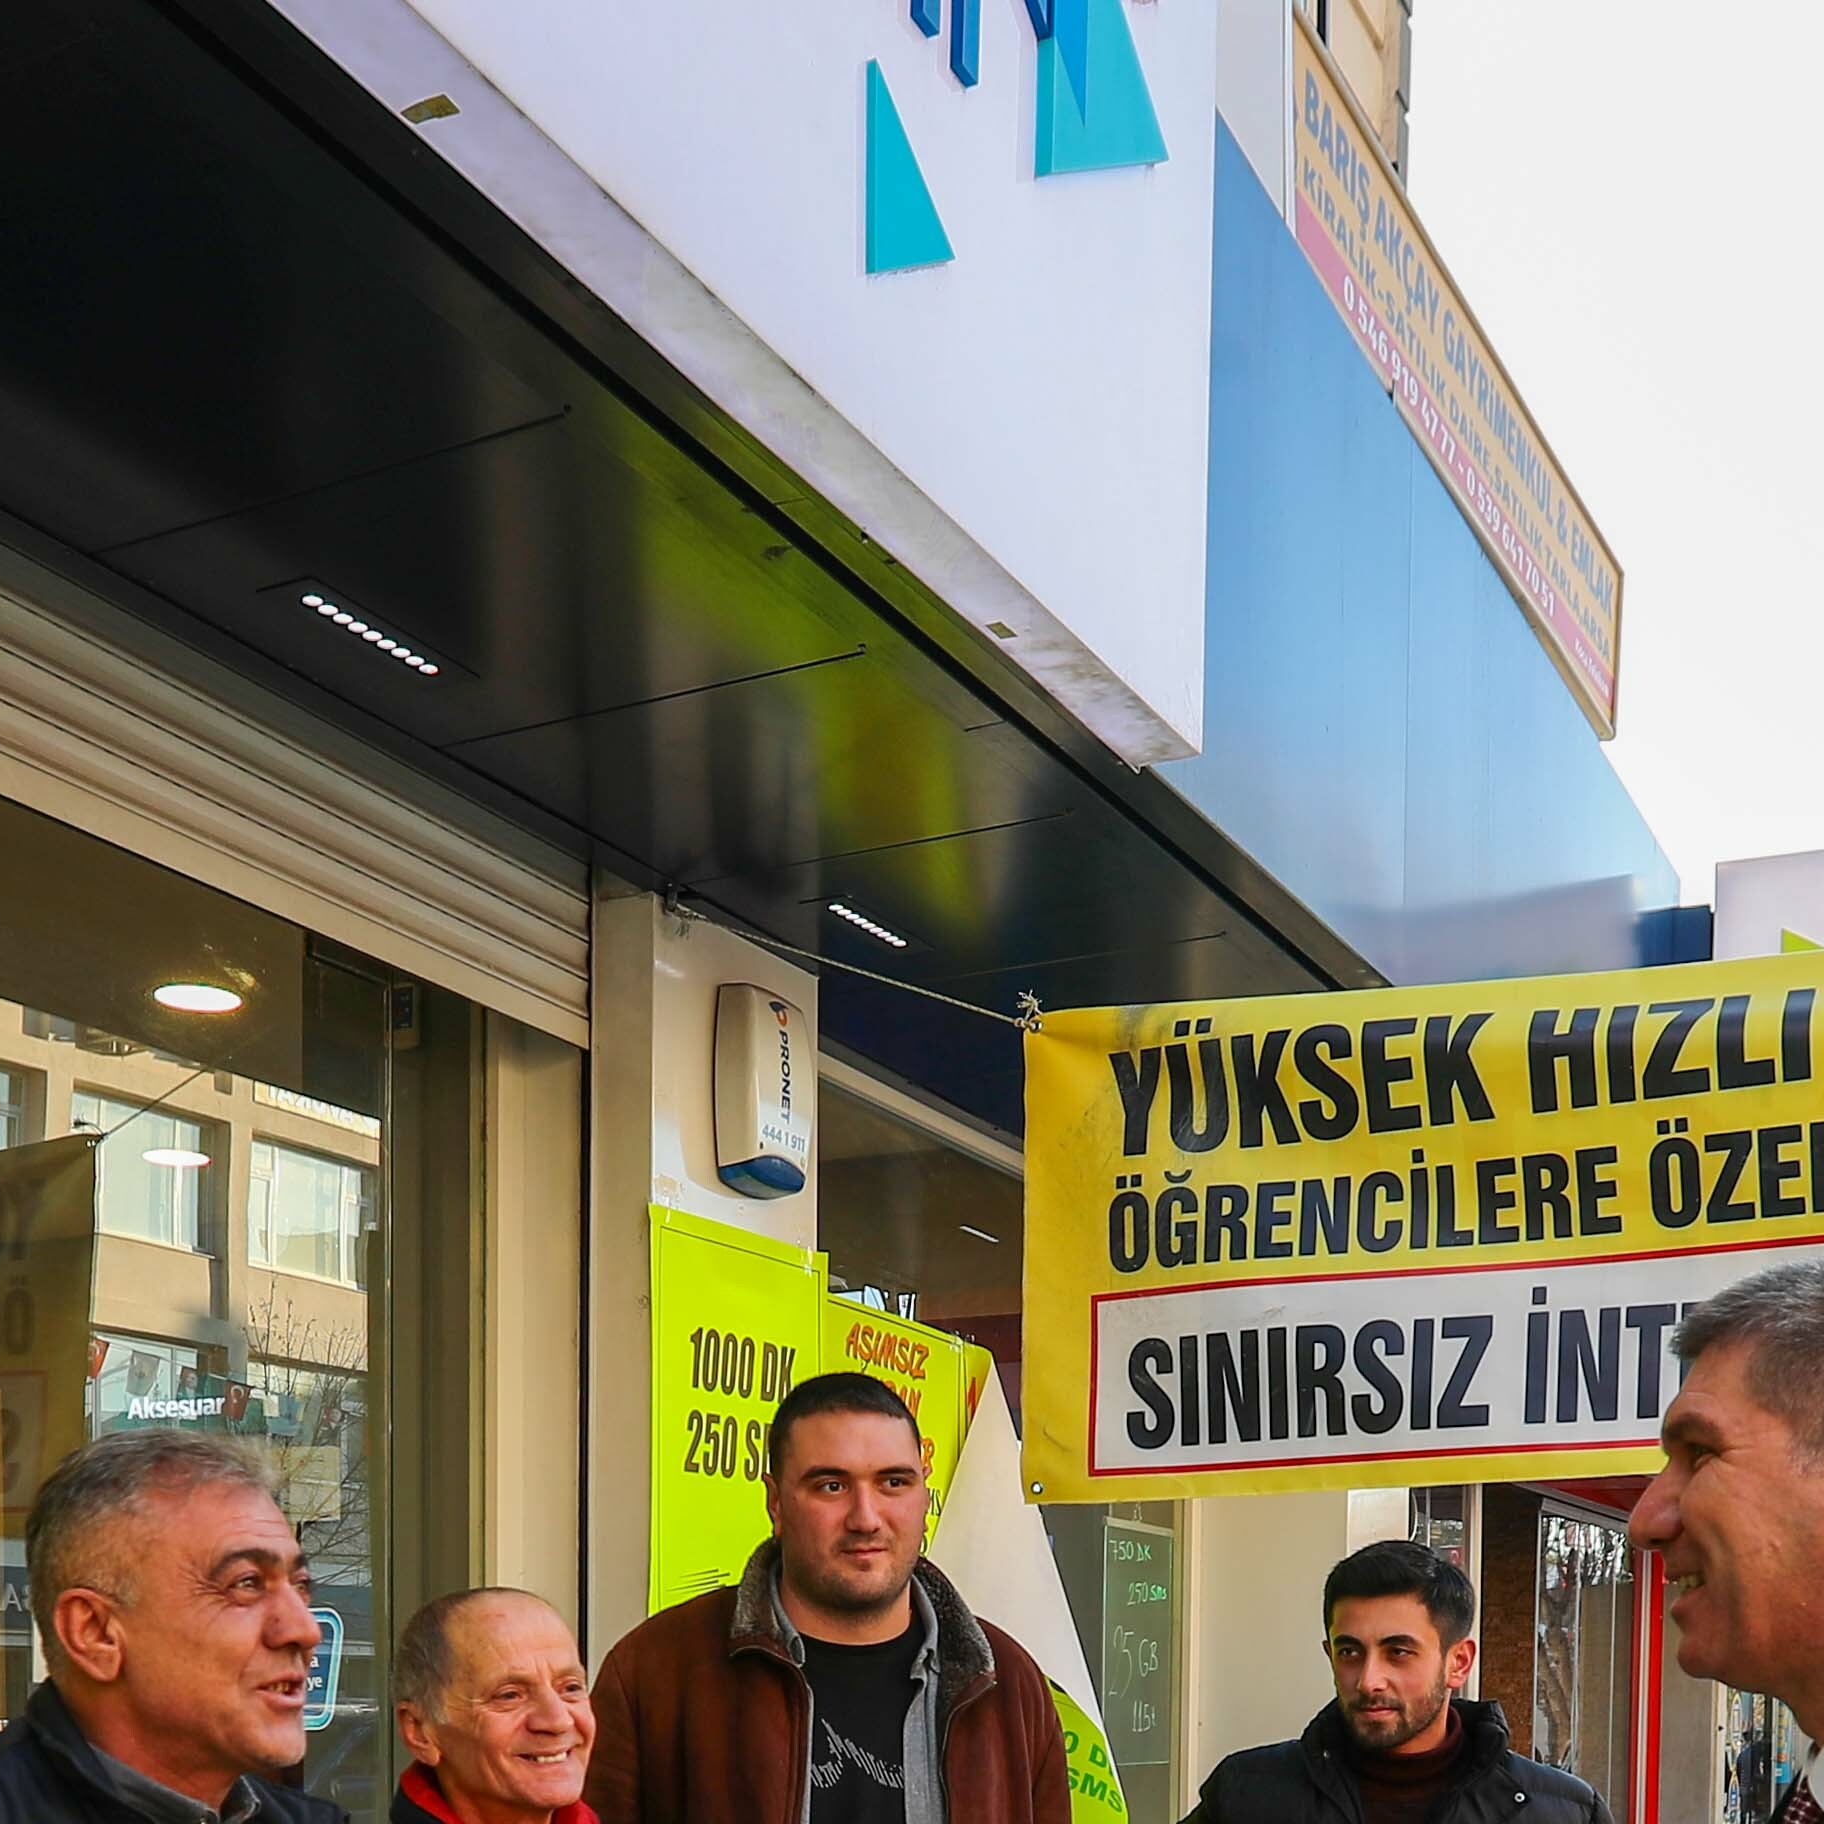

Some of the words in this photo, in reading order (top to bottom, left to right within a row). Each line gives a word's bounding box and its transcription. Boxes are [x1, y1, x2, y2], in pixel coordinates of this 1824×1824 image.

[1305, 67, 1370, 242] BARIŞ
[1375, 195, 1440, 335] AKÇAY
[1357, 302, 1389, 366] 546
[1391, 351, 1419, 406] 919
[1477, 482, 1500, 533] 539
[778, 1029, 792, 1125] PRONET
[1108, 1011, 1496, 1157] YÜKSEK
[1527, 988, 1817, 1114] HIZLI
[762, 1123, 783, 1144] 444
[791, 1131, 806, 1153] 911
[1108, 1146, 1623, 1275] ÖĞRENCİLERE
[127, 1395, 226, 1420] Aksesuar
[689, 1326, 757, 1399] 1000
[760, 1342, 797, 1403] DK
[1126, 1314, 1494, 1450] SINIRSIZ
[683, 1409, 738, 1480] 250
[1108, 1539, 1134, 1561] 750
[1138, 1638, 1159, 1678] GB
